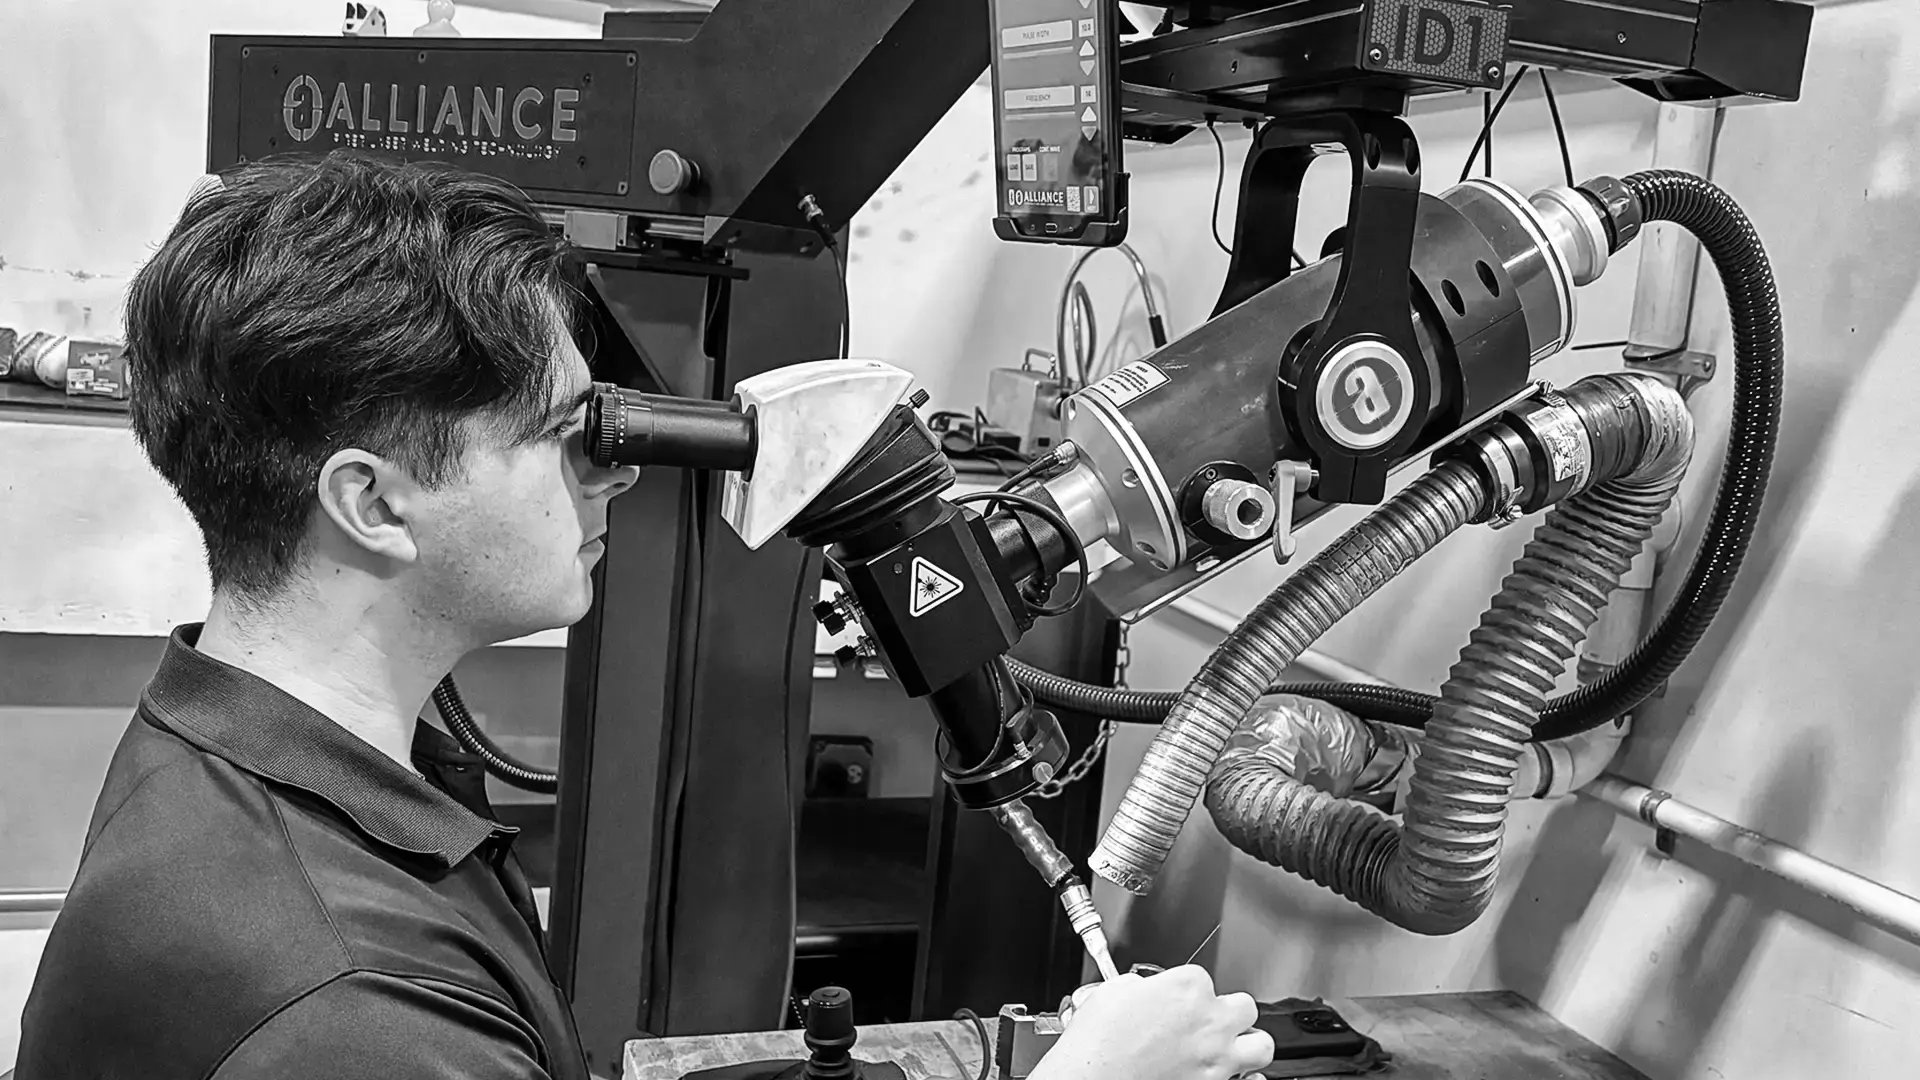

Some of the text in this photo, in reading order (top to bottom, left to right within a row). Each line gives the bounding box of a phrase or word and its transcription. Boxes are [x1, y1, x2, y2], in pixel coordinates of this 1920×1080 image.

[1395, 4, 1483, 71] ID1
[325, 82, 580, 142] ALLIANCE
[1023, 191, 1064, 204] ALLIANCE
